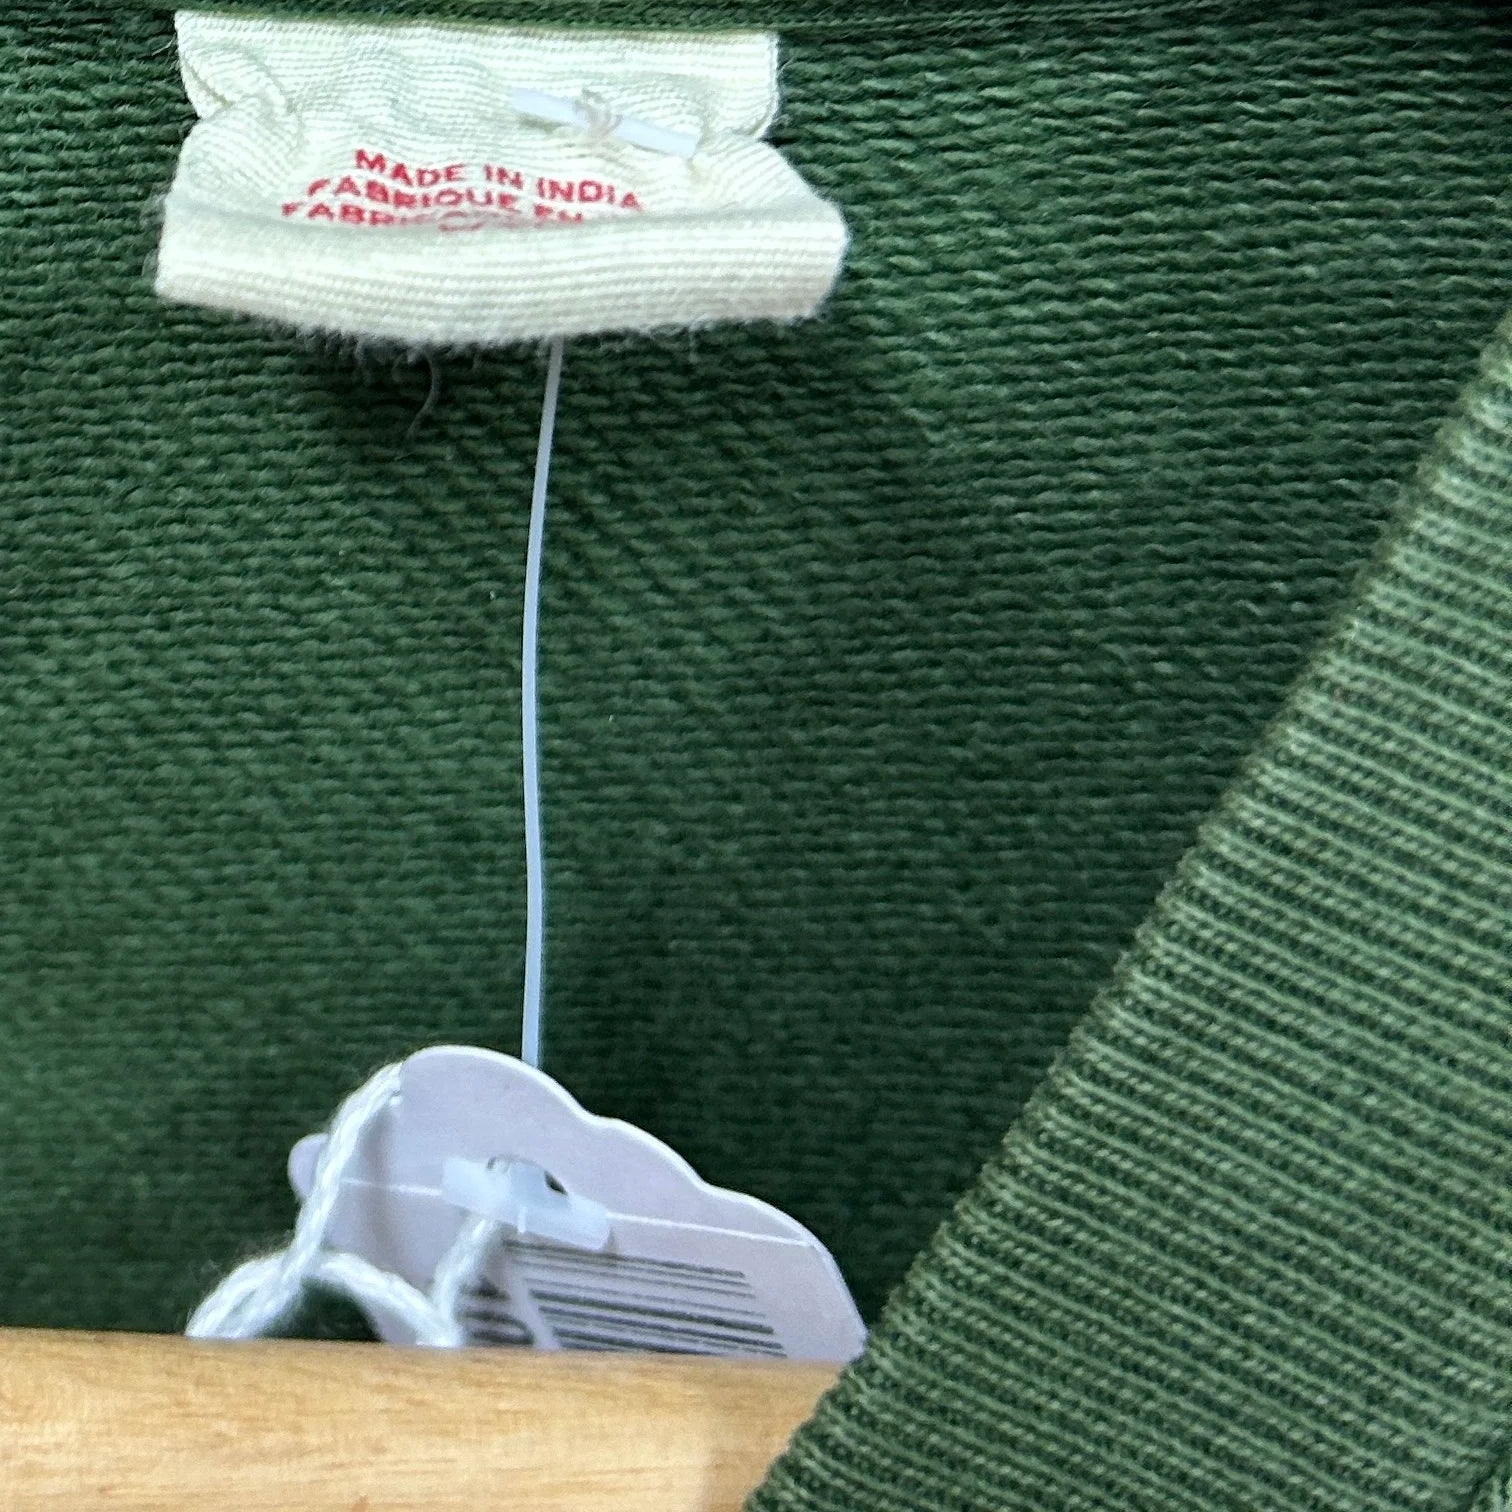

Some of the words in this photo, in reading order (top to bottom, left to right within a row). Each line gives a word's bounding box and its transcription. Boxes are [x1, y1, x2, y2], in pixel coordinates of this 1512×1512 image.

[354, 149, 468, 187] MADE
[483, 163, 524, 190] IN
[536, 176, 643, 212] INDIA
